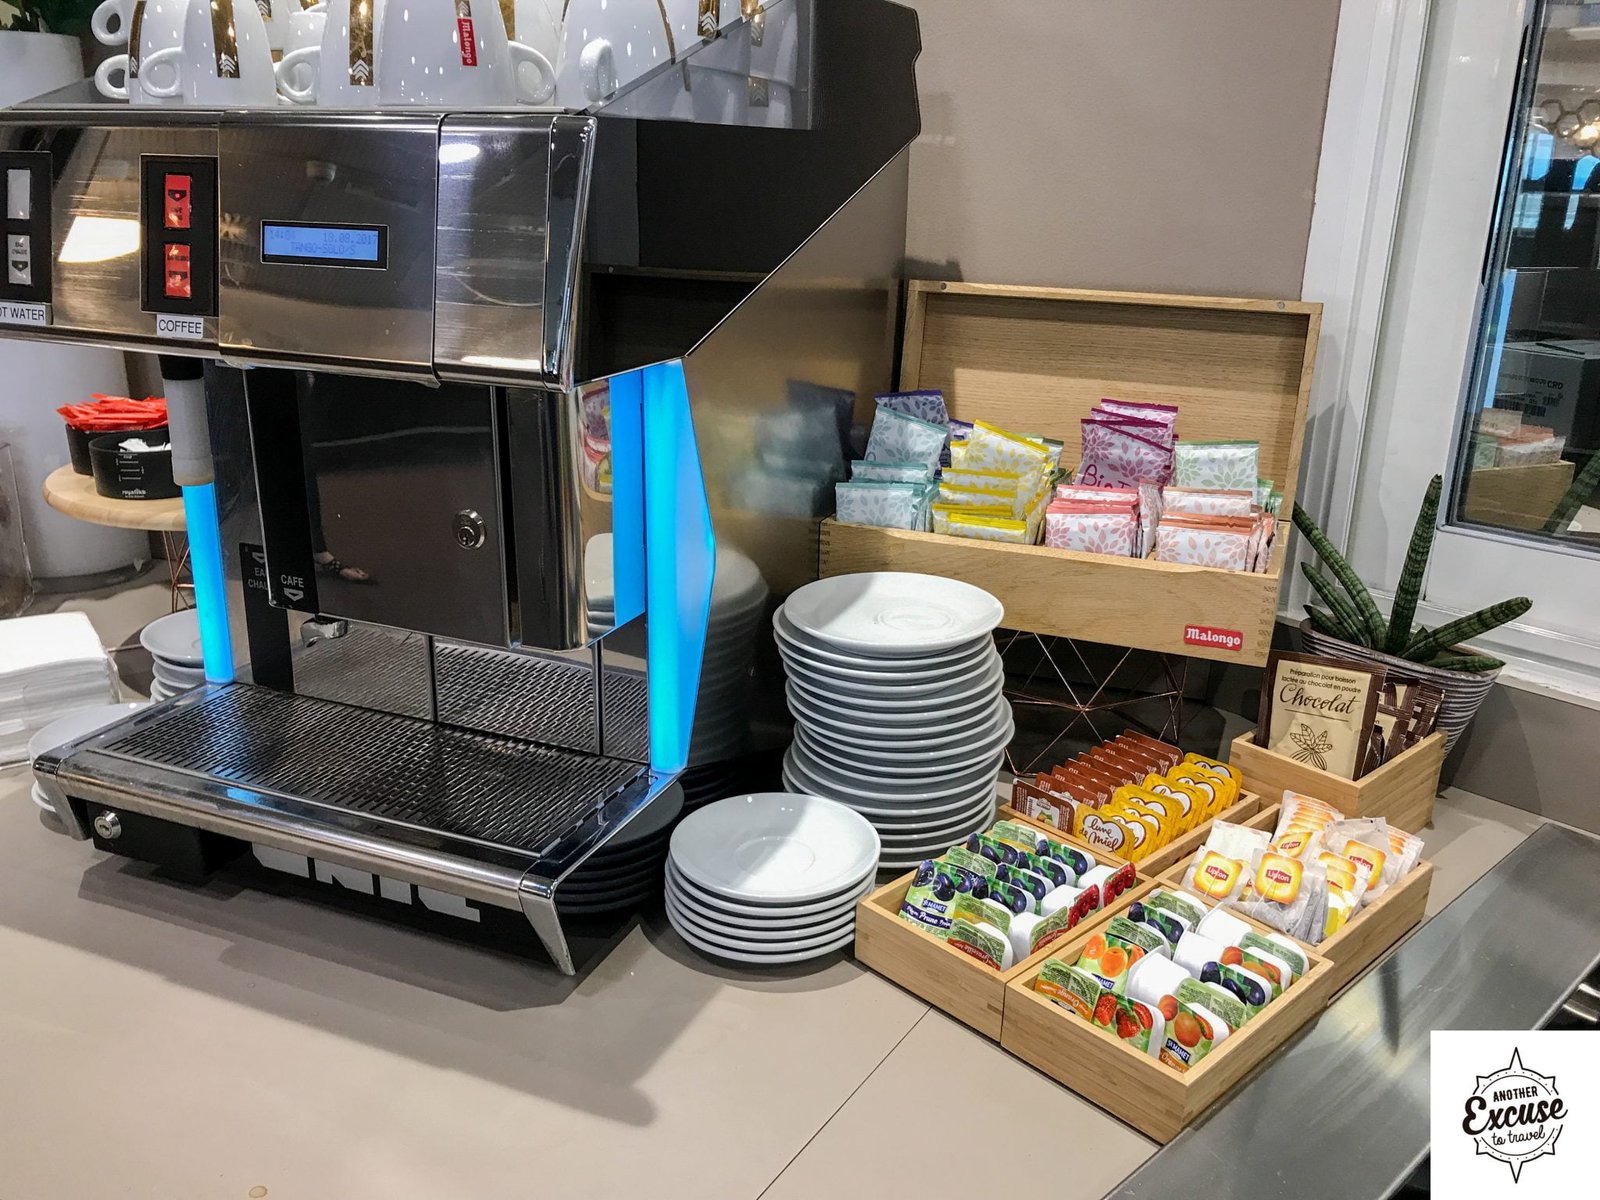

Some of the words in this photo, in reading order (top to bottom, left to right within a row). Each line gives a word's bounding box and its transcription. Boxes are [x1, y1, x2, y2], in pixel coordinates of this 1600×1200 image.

[9, 306, 45, 321] WATER
[158, 319, 202, 334] COFFEE
[254, 567, 266, 577] EA
[280, 574, 305, 588] CAFE
[1186, 628, 1241, 648] Malongo
[1289, 668, 1321, 679] Préparation
[1335, 676, 1357, 684] boisson
[1307, 680, 1333, 689] chocolat
[1280, 683, 1362, 714] Chocolat
[1207, 866, 1229, 881] Lipton
[1267, 869, 1291, 884] Lipton
[918, 912, 938, 925] Prune
